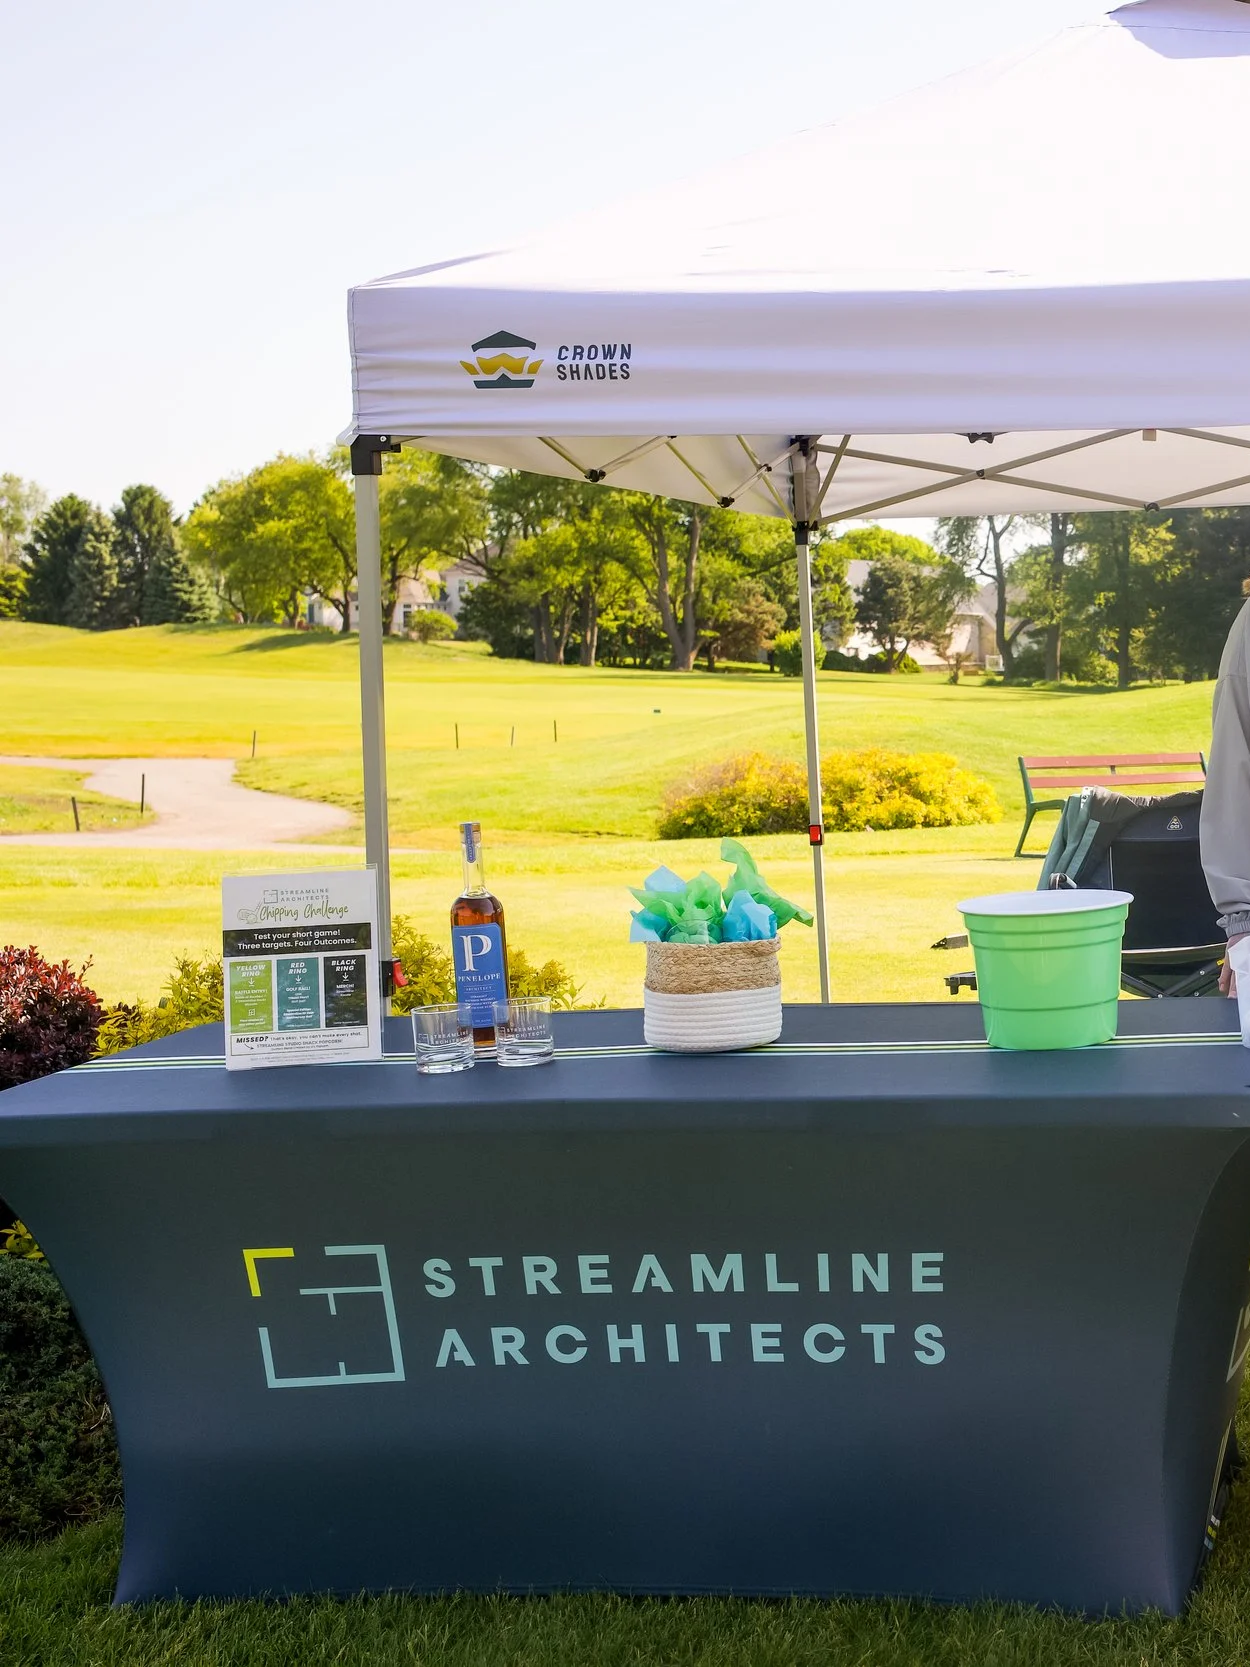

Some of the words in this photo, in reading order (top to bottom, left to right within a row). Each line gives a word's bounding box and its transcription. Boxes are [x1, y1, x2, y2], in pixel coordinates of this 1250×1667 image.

[557, 343, 632, 361] CROWN
[556, 363, 631, 381] SHADES
[260, 903, 299, 922] Chipping
[303, 900, 349, 919] Challenge
[237, 942, 261, 950] Three
[261, 940, 293, 950] targets.
[313, 938, 357, 946] Outcomes.
[254, 933, 272, 941] Test
[272, 933, 291, 942] your
[292, 931, 313, 939] short
[314, 929, 341, 939] game!
[460, 934, 492, 972] P
[241, 970, 261, 978] RING
[458, 973, 501, 982] PENELOPE
[236, 1035, 269, 1043] MISSED?
[423, 1252, 946, 1299] STREAMLINE
[435, 1323, 946, 1369] ARCHITECTS
